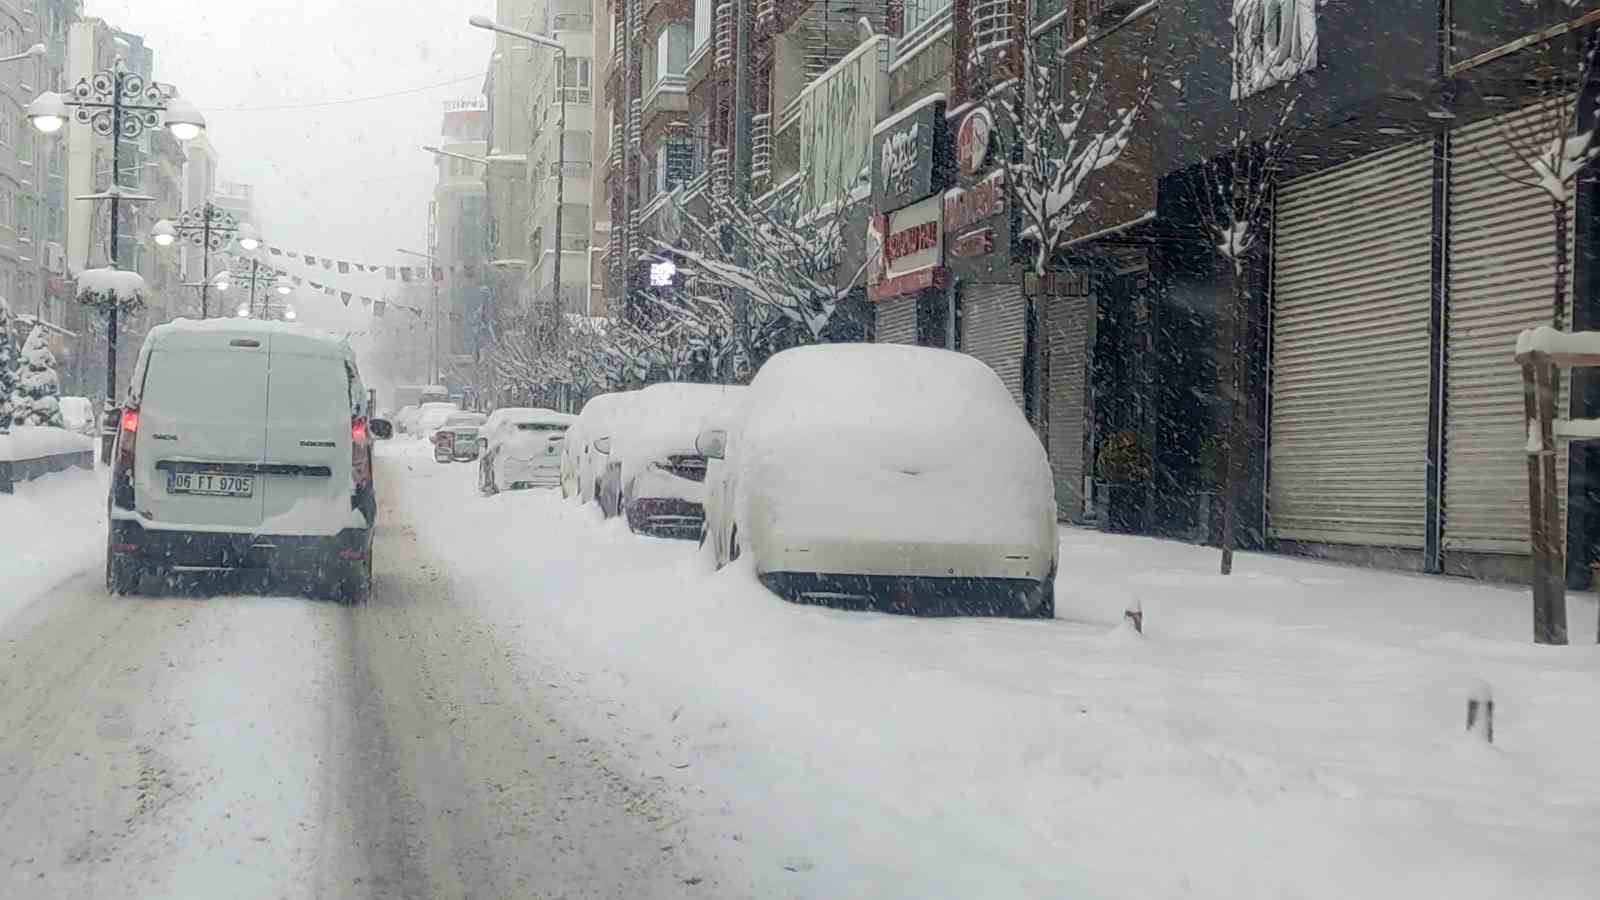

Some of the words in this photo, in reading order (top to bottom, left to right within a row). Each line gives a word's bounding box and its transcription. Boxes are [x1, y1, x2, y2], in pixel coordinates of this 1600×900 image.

[176, 475, 192, 488] 06
[198, 475, 213, 489] FT
[220, 477, 250, 491] 9705
